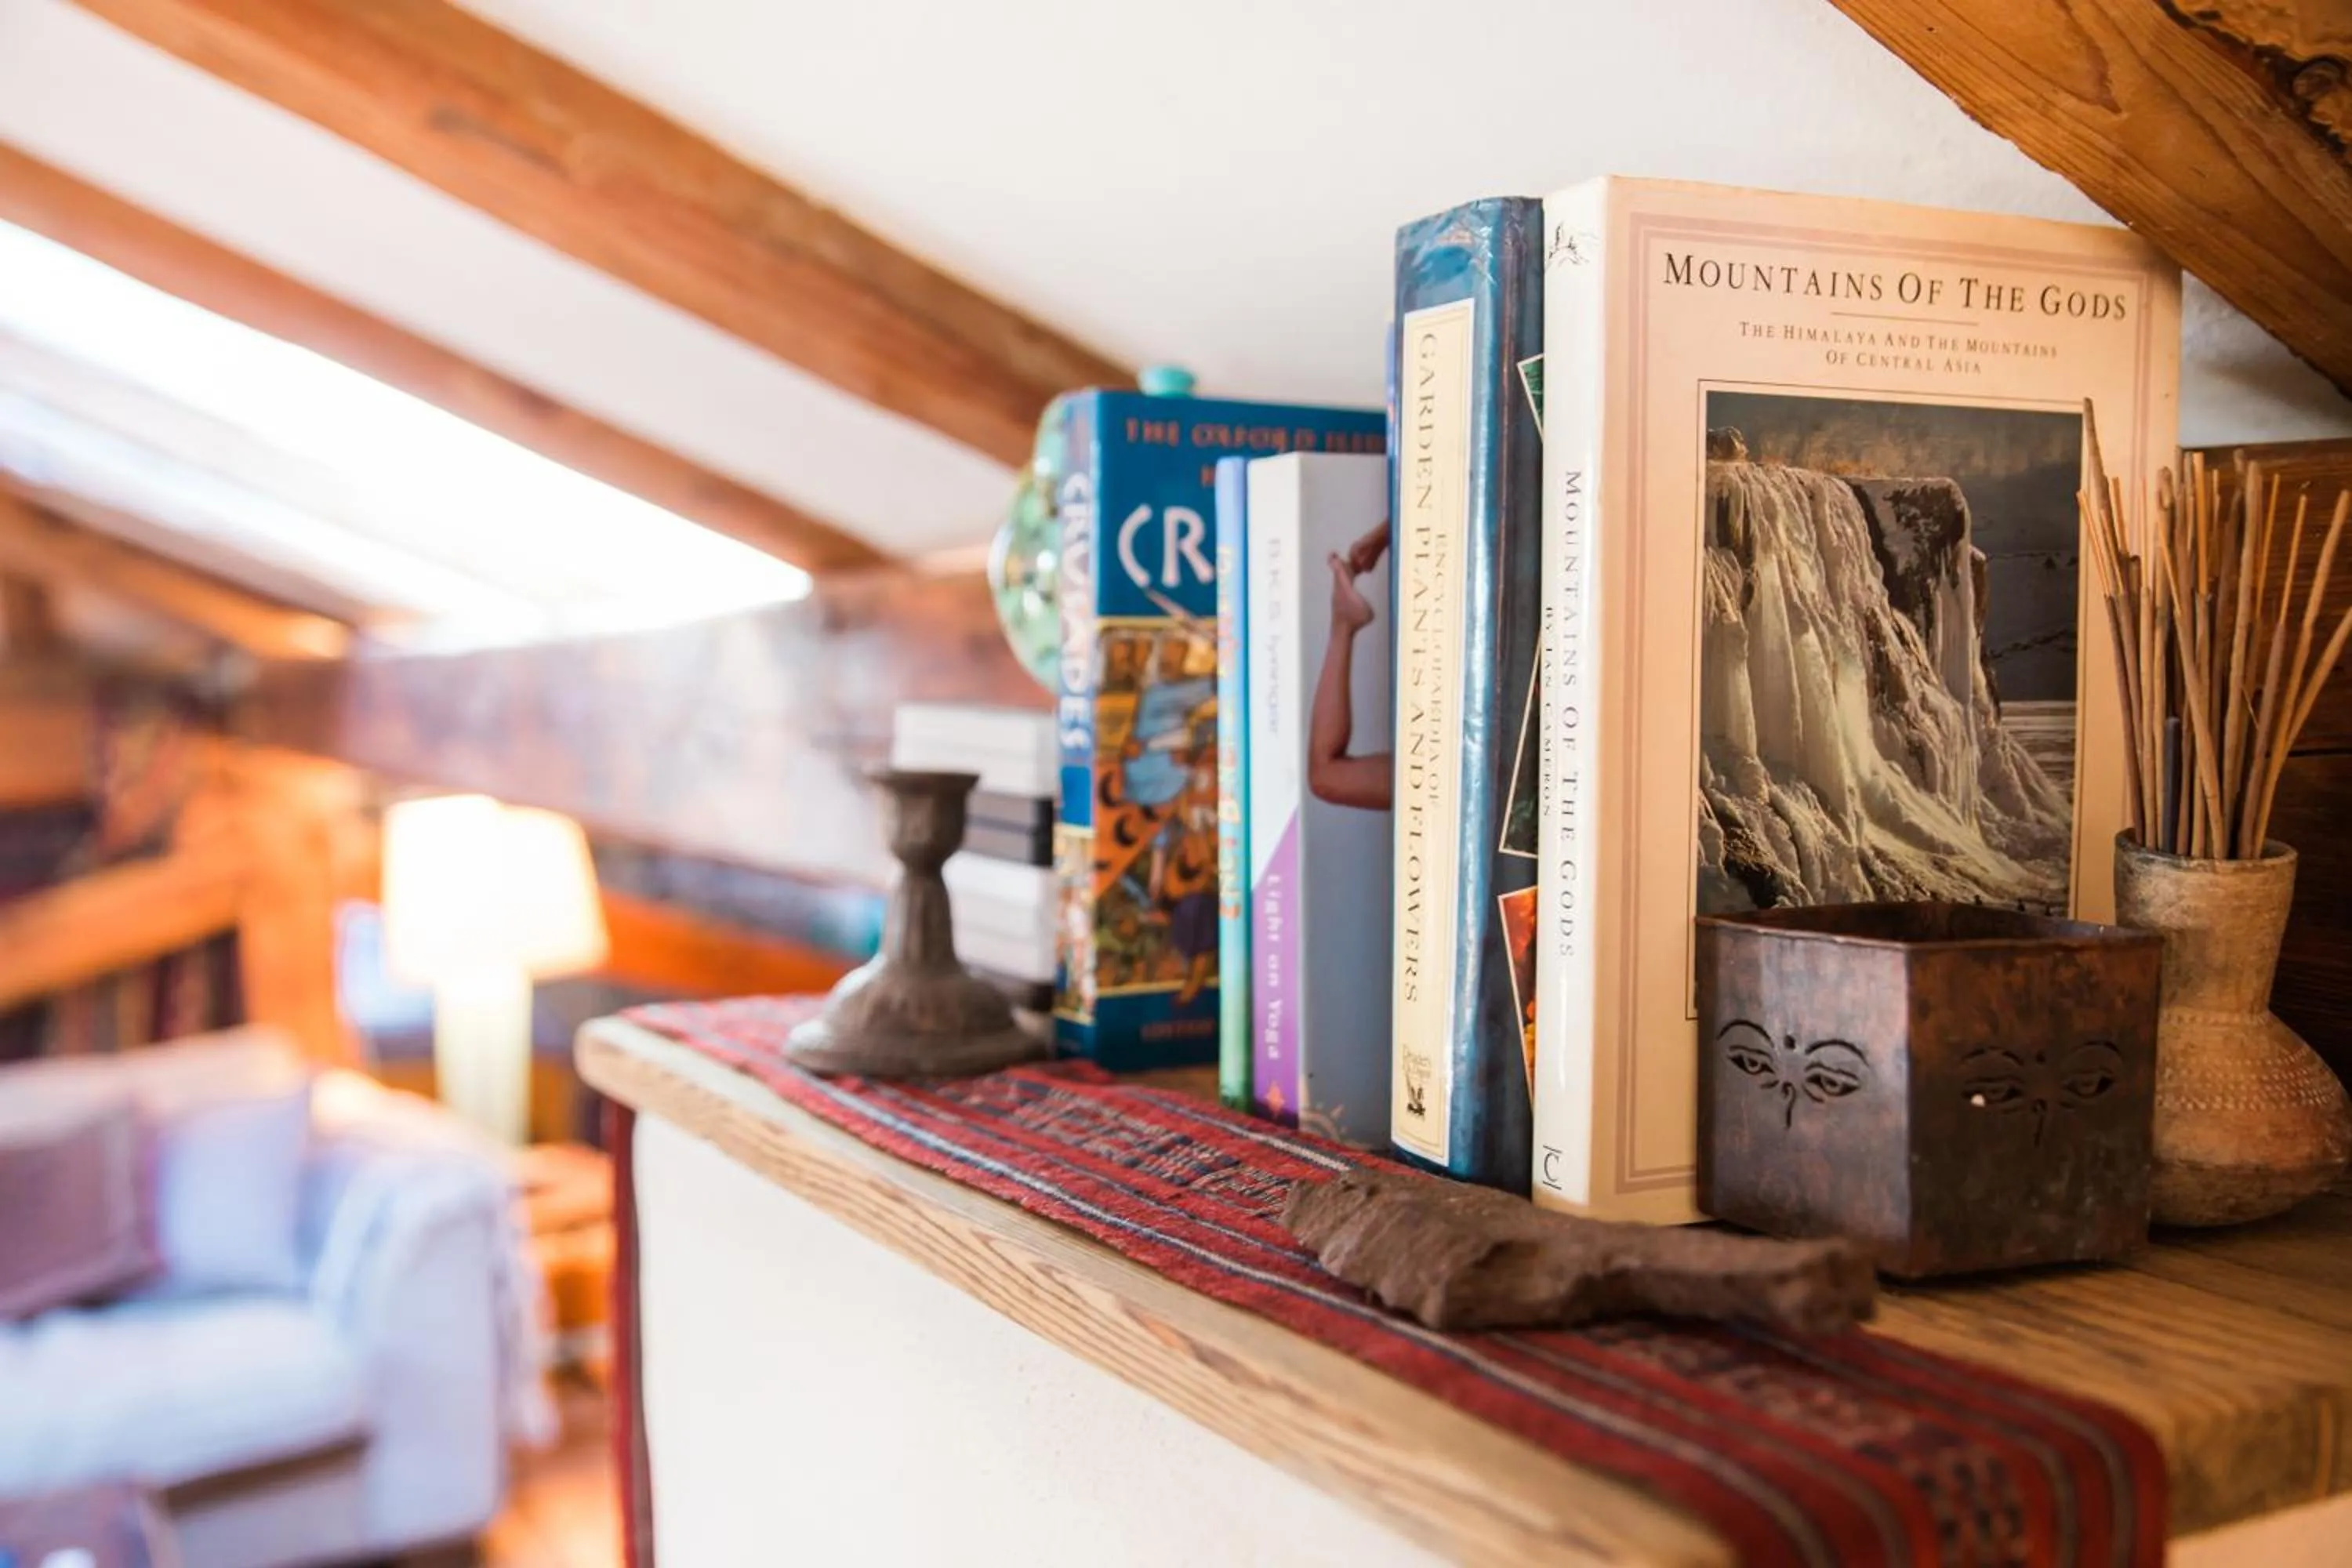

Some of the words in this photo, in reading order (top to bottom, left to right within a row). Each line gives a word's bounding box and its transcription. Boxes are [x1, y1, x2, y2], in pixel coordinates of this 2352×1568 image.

[1663, 252, 1883, 301] MOUNTAINS
[1898, 272, 1944, 305] OF
[1959, 277, 2025, 313] THE
[2040, 284, 2127, 321] GODS
[1739, 321, 1774, 339] THE
[1784, 325, 1876, 345] HIMALAYA
[1884, 332, 1921, 350] AND
[1928, 335, 1959, 352] THE
[1966, 338, 2058, 359] MOUNTAINS
[1825, 350, 1849, 365] OF
[1856, 352, 1934, 372] CENTRAL
[1944, 358, 1982, 375] ASIA
[1416, 332, 1438, 510] GARDEN
[1412, 527, 1432, 687] PLANTS
[1563, 470, 1582, 687] MOUNTAINS
[1410, 702, 1425, 790] AND
[1562, 706, 1580, 751] OF
[1561, 772, 1579, 842] THE
[1264, 874, 1282, 942] Light
[1404, 805, 1424, 1003] FLOWERS
[1559, 859, 1577, 957] GODS
[1266, 953, 1281, 987] on
[1264, 999, 1283, 1061] Yoga
